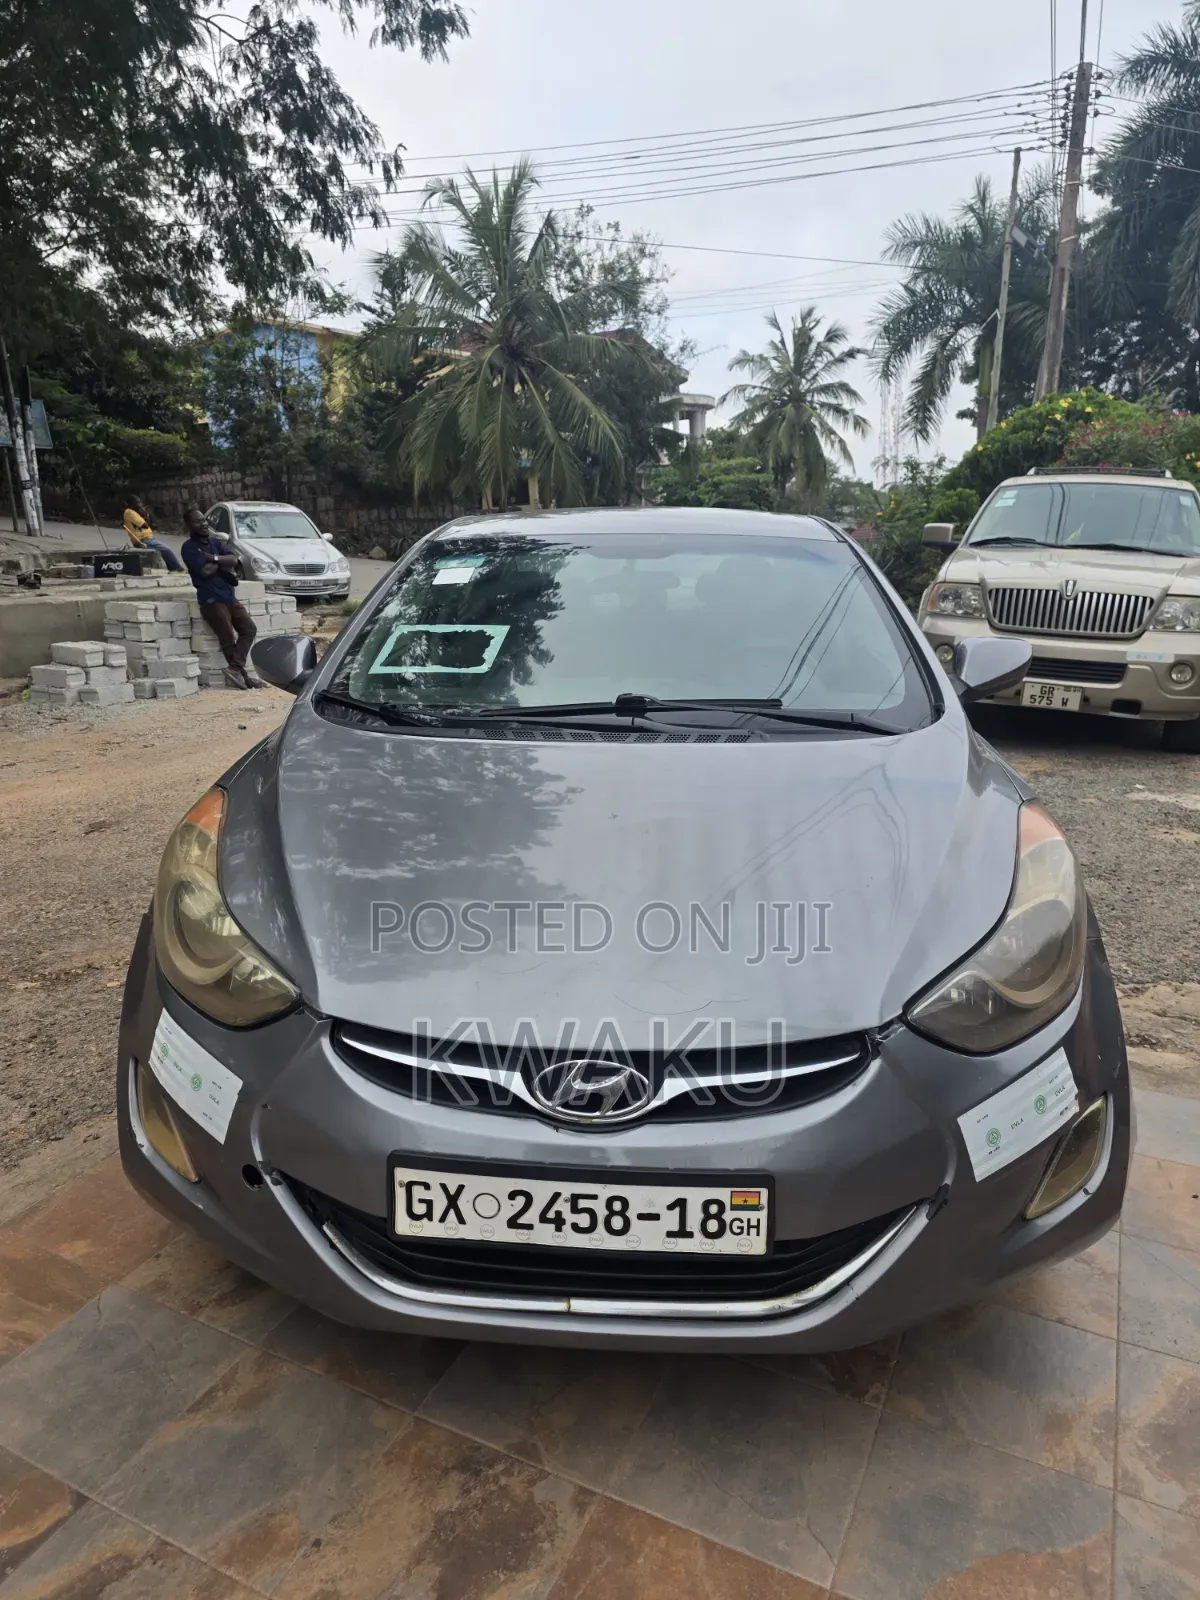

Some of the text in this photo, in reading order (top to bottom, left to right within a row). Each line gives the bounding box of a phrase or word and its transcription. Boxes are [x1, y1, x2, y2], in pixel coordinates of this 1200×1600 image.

[1040, 685, 1055, 696] GR
[1029, 694, 1069, 707] 575 W
[1010, 1117, 1024, 1130] DVLA
[404, 1180, 727, 1240] GX 2458-18
[729, 1217, 761, 1236] GH
